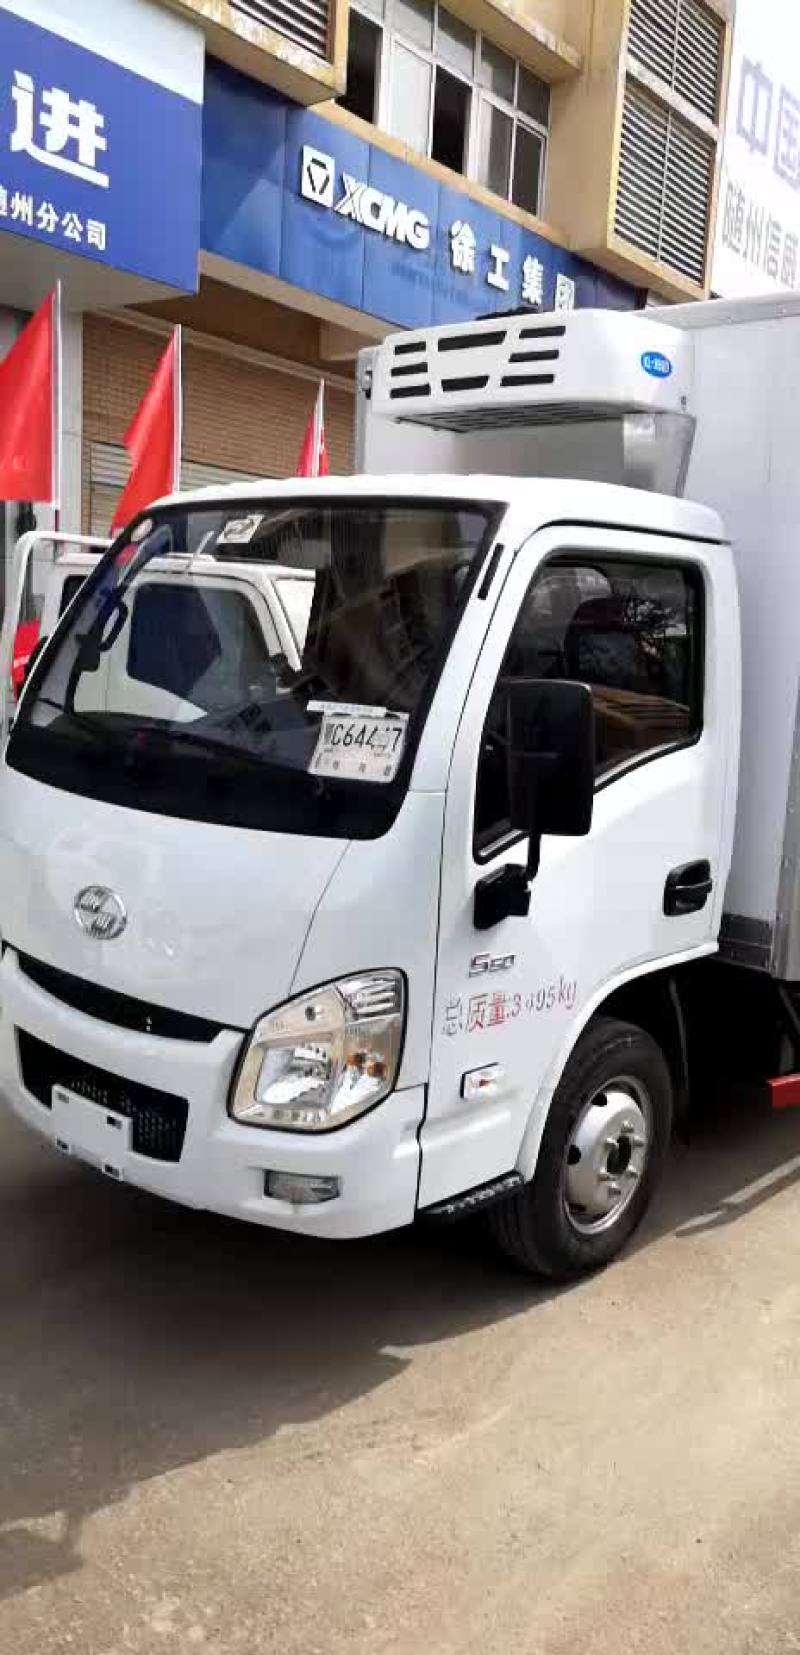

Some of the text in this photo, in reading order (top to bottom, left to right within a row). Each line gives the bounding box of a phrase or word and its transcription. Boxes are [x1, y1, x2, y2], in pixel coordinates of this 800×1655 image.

[10, 70, 109, 189] 进
[334, 172, 575, 312] XCMG 徐工集团
